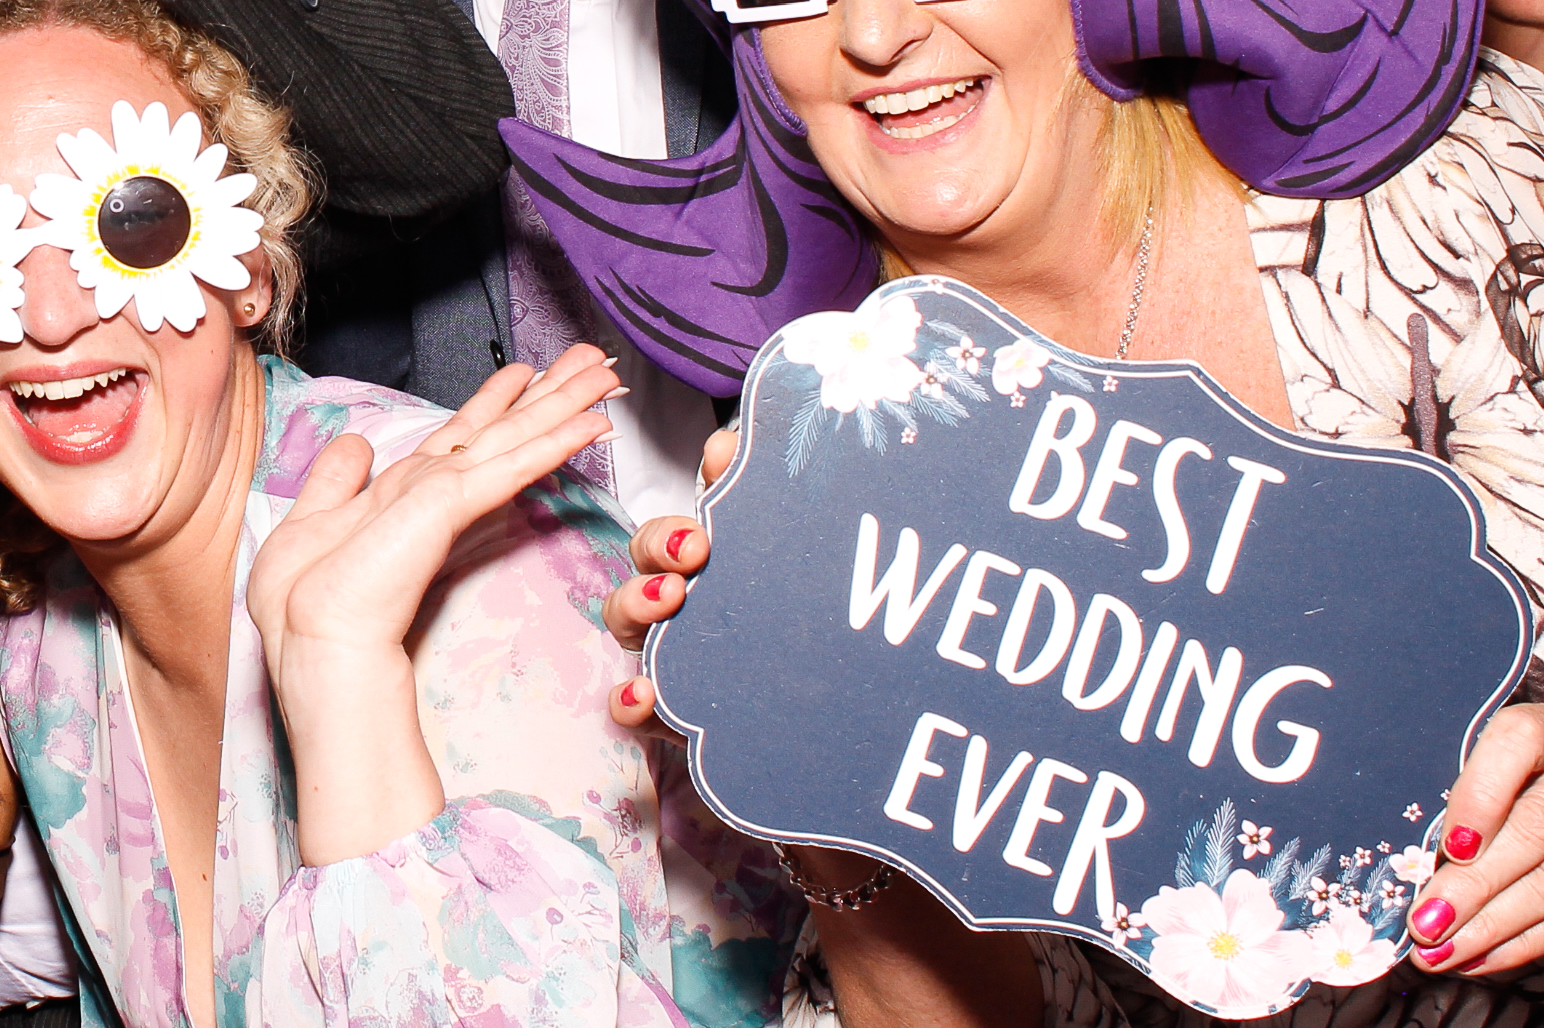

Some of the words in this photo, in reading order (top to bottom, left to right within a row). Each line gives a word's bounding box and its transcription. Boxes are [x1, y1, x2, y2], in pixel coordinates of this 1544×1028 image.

[1008, 391, 1286, 595] BEST
[848, 512, 1333, 784] WEDDING
[883, 711, 1146, 921] EVER
